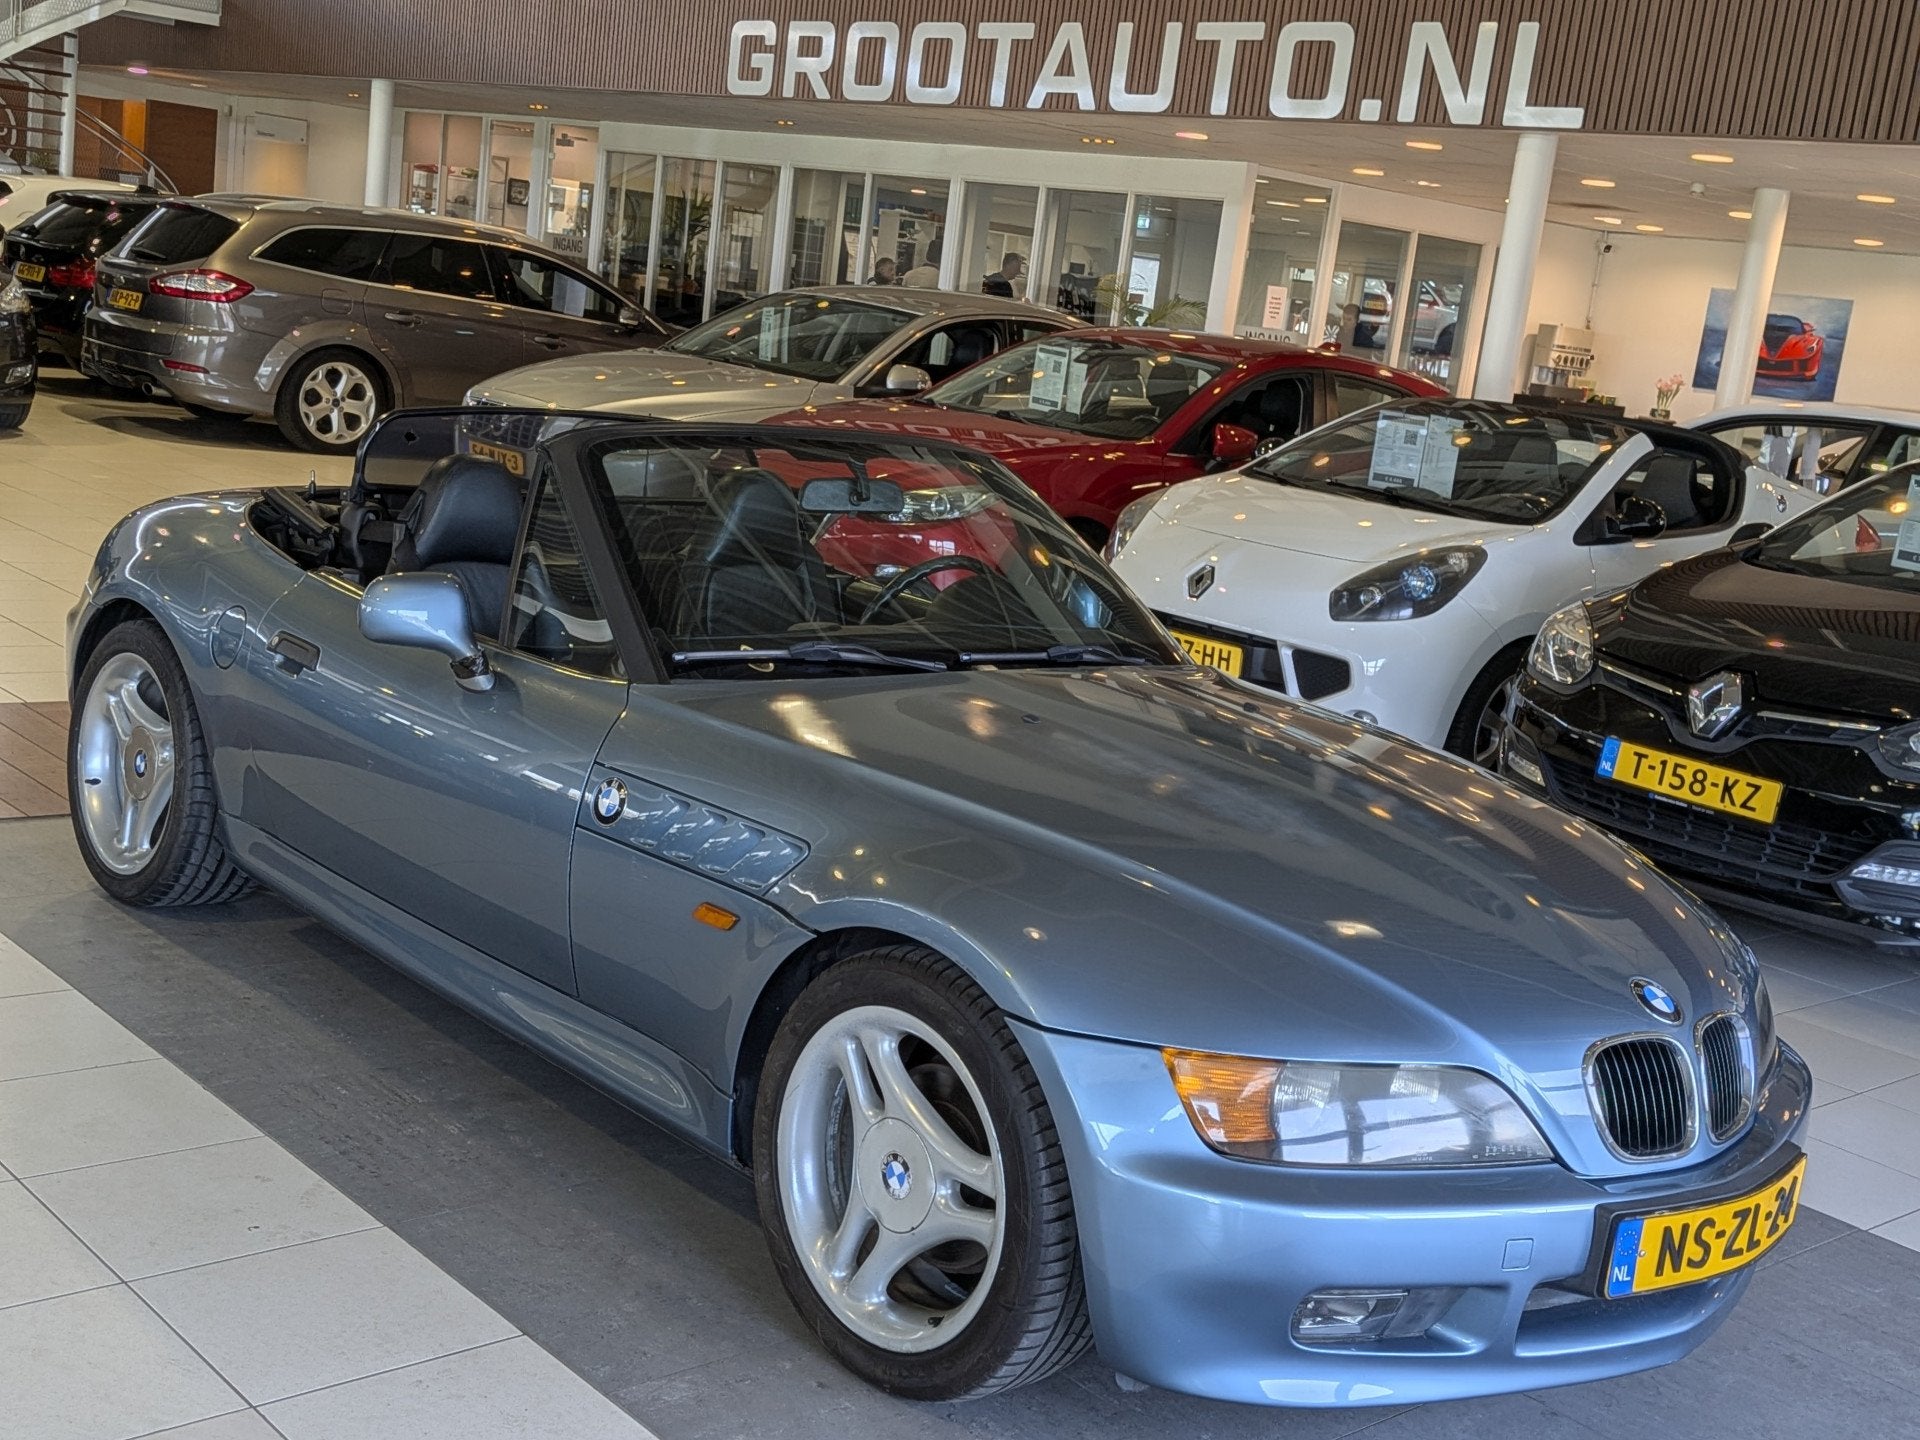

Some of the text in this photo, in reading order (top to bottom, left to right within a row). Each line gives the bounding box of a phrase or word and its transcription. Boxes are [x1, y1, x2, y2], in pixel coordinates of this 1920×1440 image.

[727, 20, 1585, 129] GROOTAUTO.NL
[552, 237, 583, 253] INGANG
[1601, 760, 1613, 772] NL
[1632, 751, 1763, 813] T-158-KZ
[1612, 1175, 1799, 1283] NL NS-ZL-24
